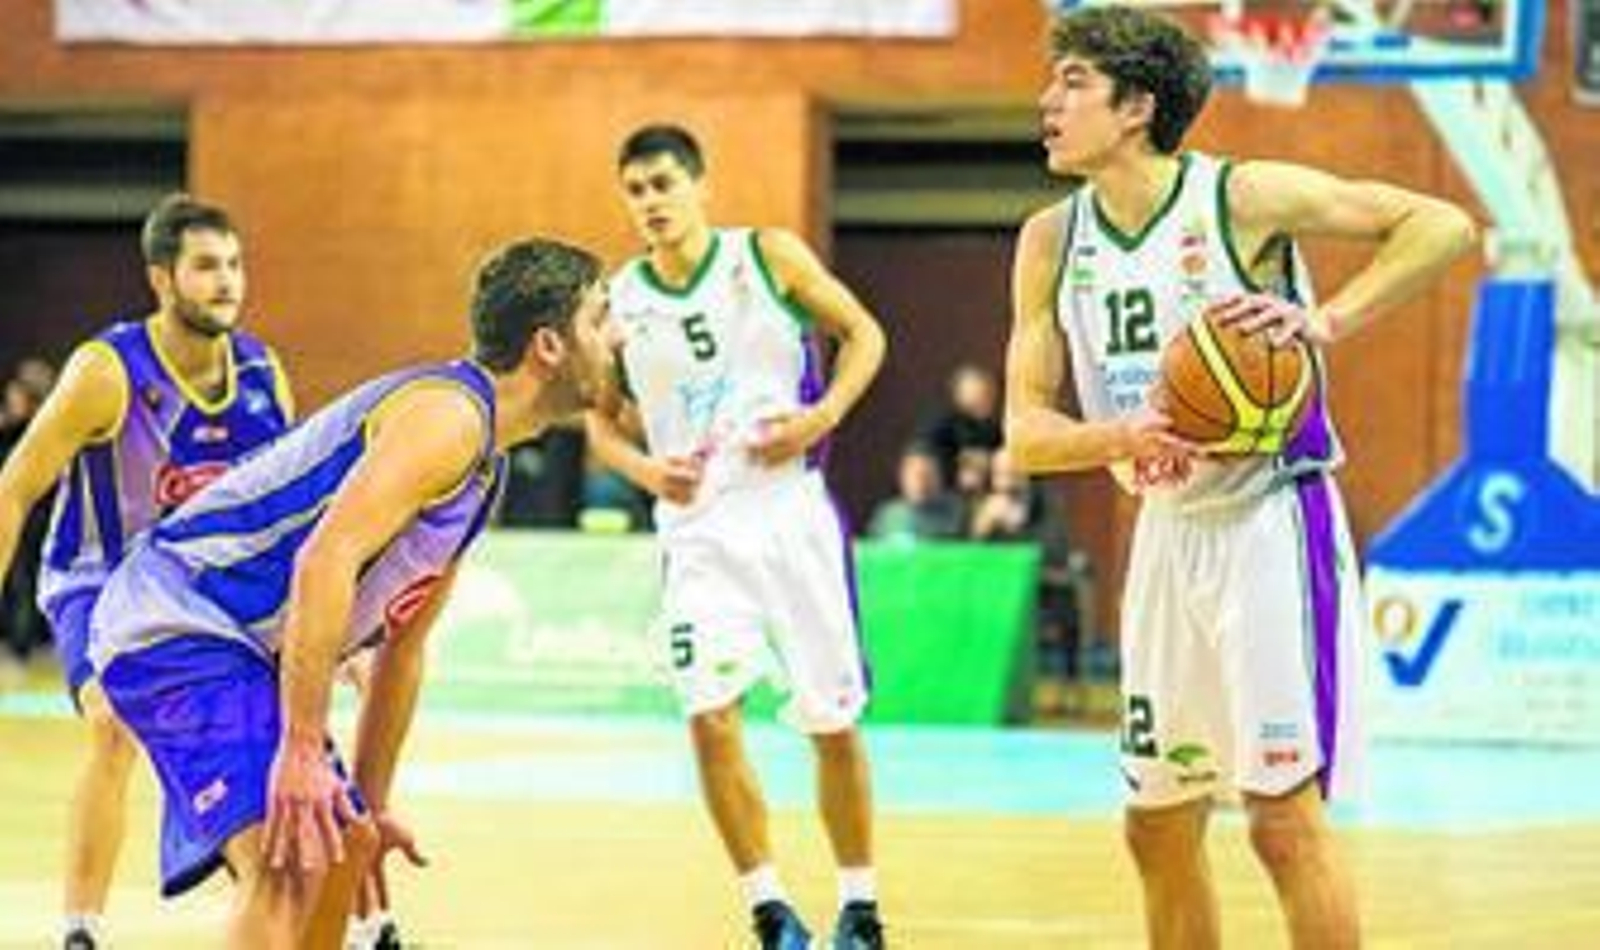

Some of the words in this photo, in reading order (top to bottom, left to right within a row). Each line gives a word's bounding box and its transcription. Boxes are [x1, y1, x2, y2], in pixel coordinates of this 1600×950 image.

[681, 312, 717, 362] 5
[1105, 289, 1159, 355] 12
[1469, 474, 1525, 552] S
[671, 623, 693, 670] 5
